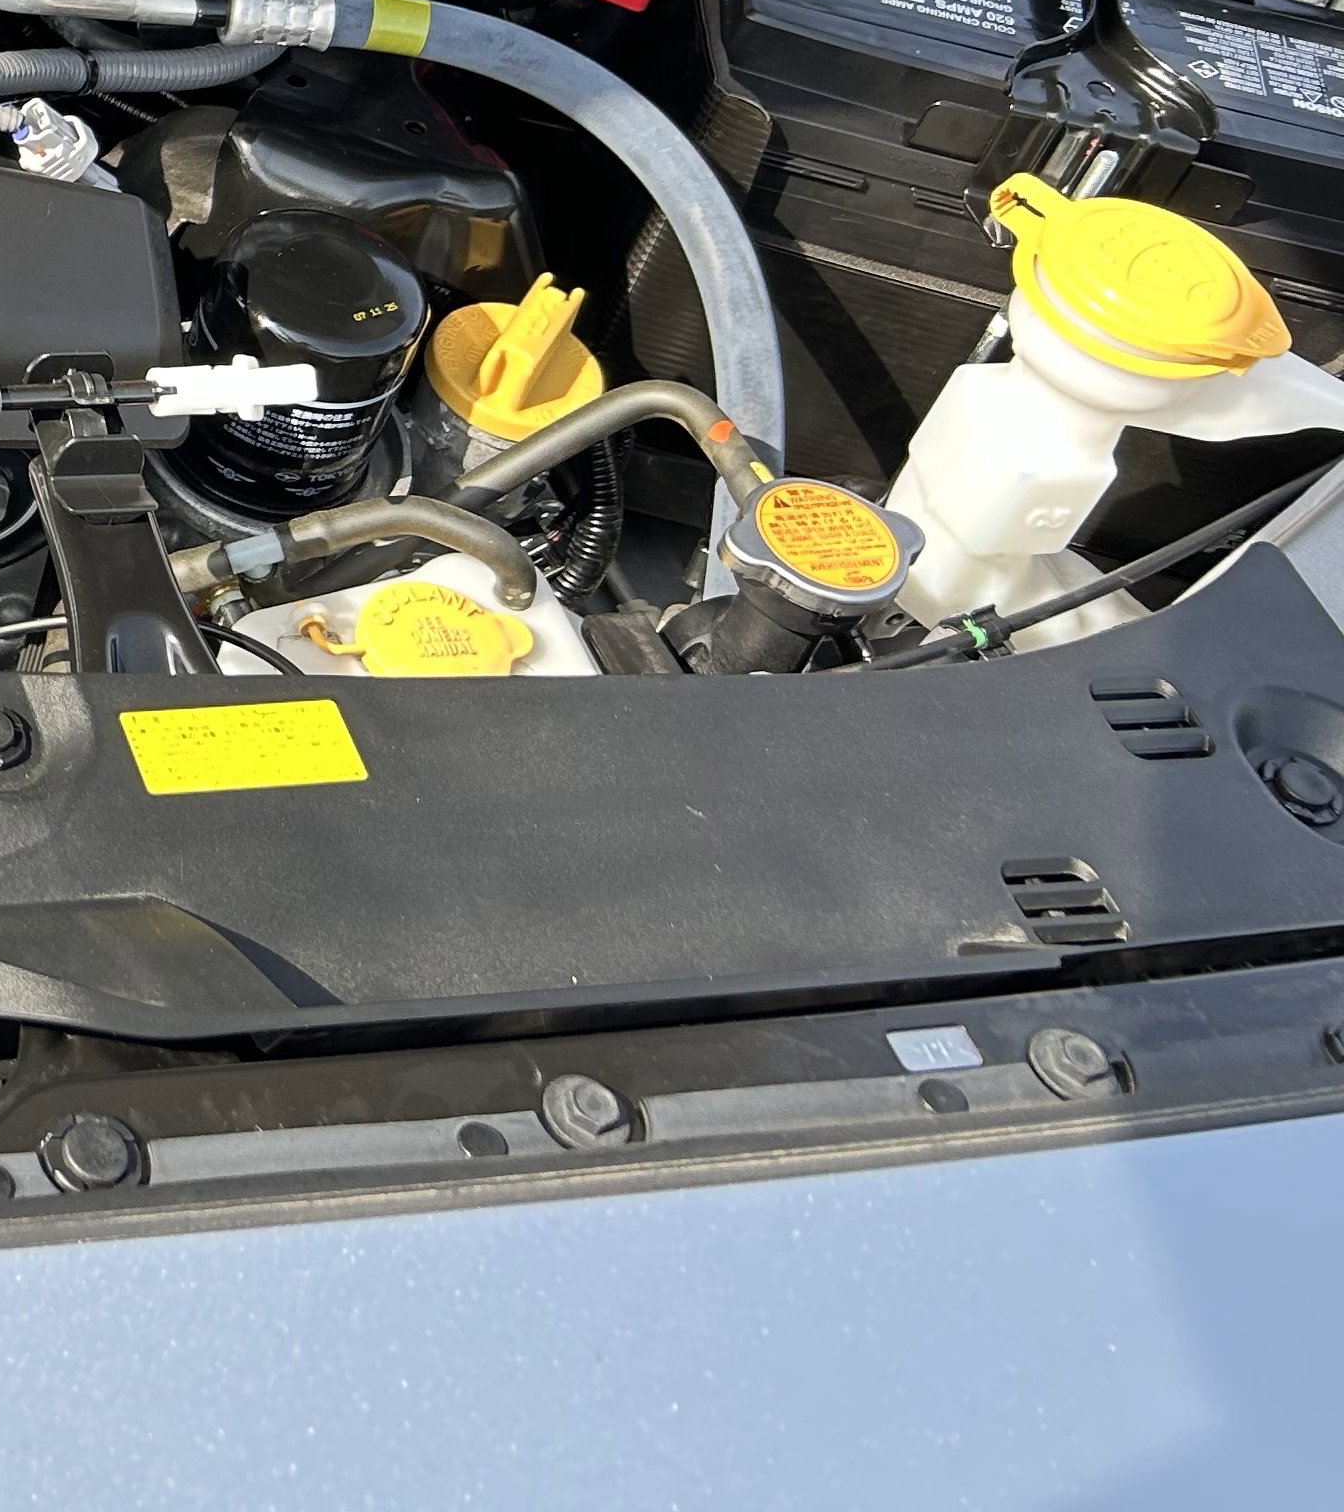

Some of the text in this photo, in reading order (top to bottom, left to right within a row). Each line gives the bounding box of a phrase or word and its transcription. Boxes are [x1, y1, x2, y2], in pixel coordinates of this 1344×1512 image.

[916, 4, 981, 27] CRANKING
[986, 11, 1015, 25] 620
[982, 20, 1016, 35] COLD
[1292, 98, 1344, 118] OISON
